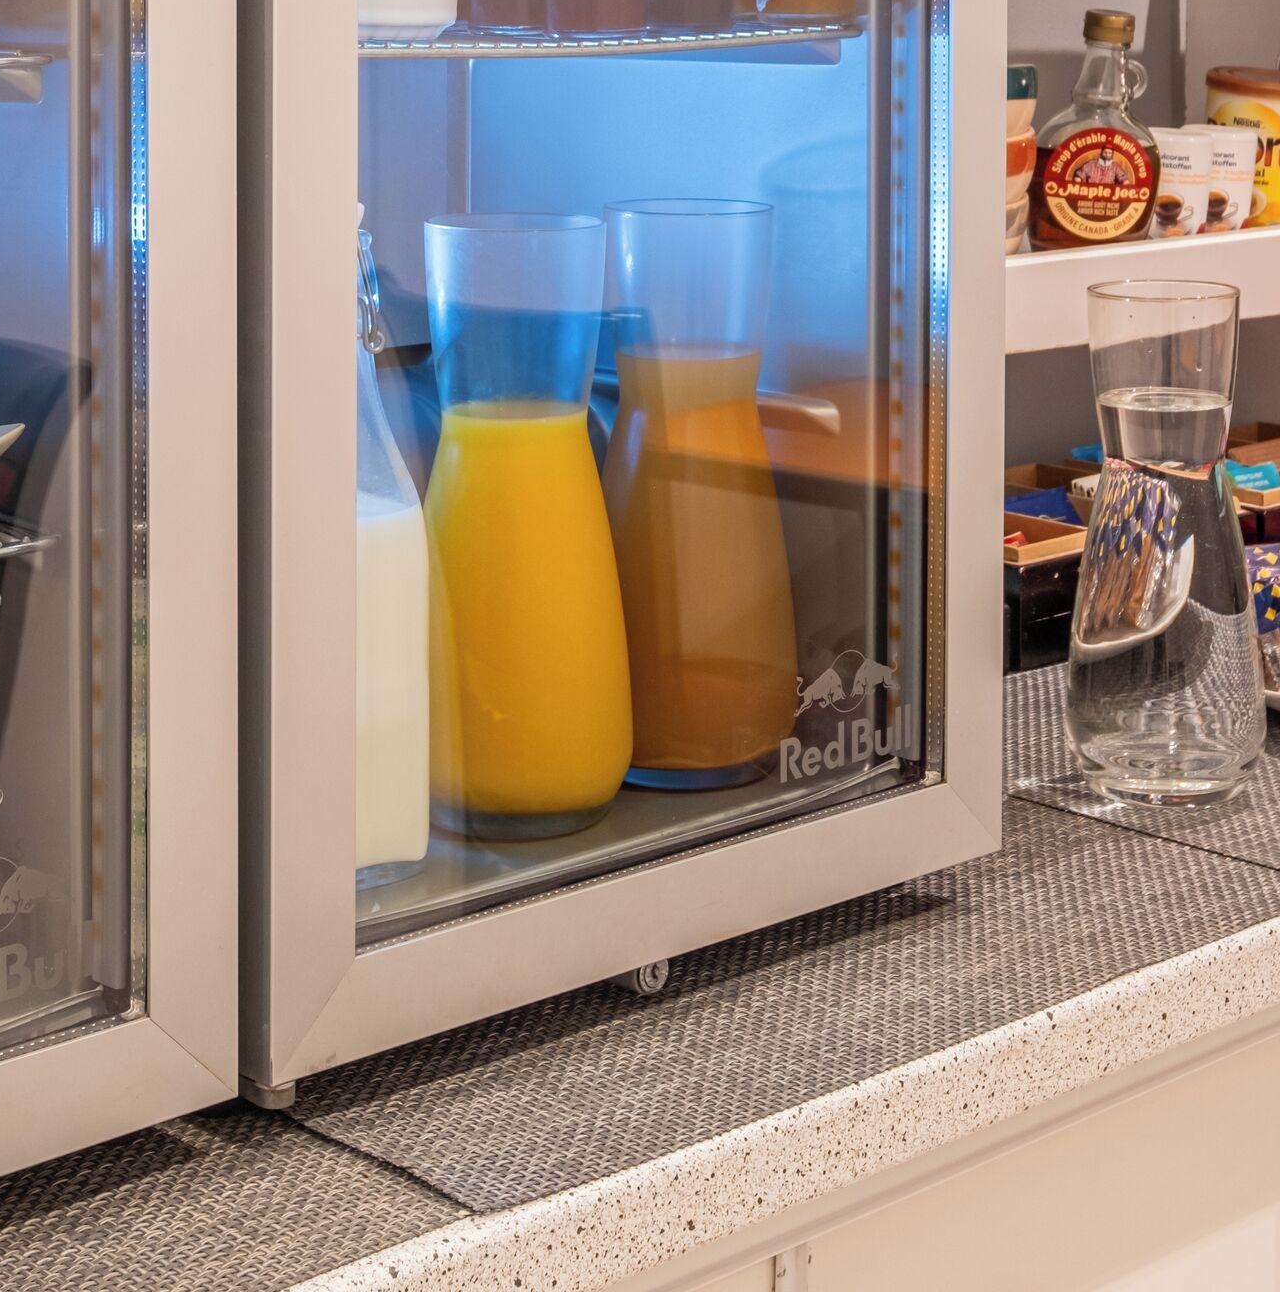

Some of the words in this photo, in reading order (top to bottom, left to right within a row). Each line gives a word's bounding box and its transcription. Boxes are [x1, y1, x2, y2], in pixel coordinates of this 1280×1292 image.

[1233, 116, 1261, 129] Nestlé
[1052, 149, 1072, 174] Sirop
[1113, 134, 1137, 152] Maple
[1133, 150, 1147, 179] syrup
[1058, 183, 1112, 200] Maple
[1079, 224, 1109, 236] CANADA
[780, 720, 845, 784] Red
[851, 703, 912, 763] Bull
